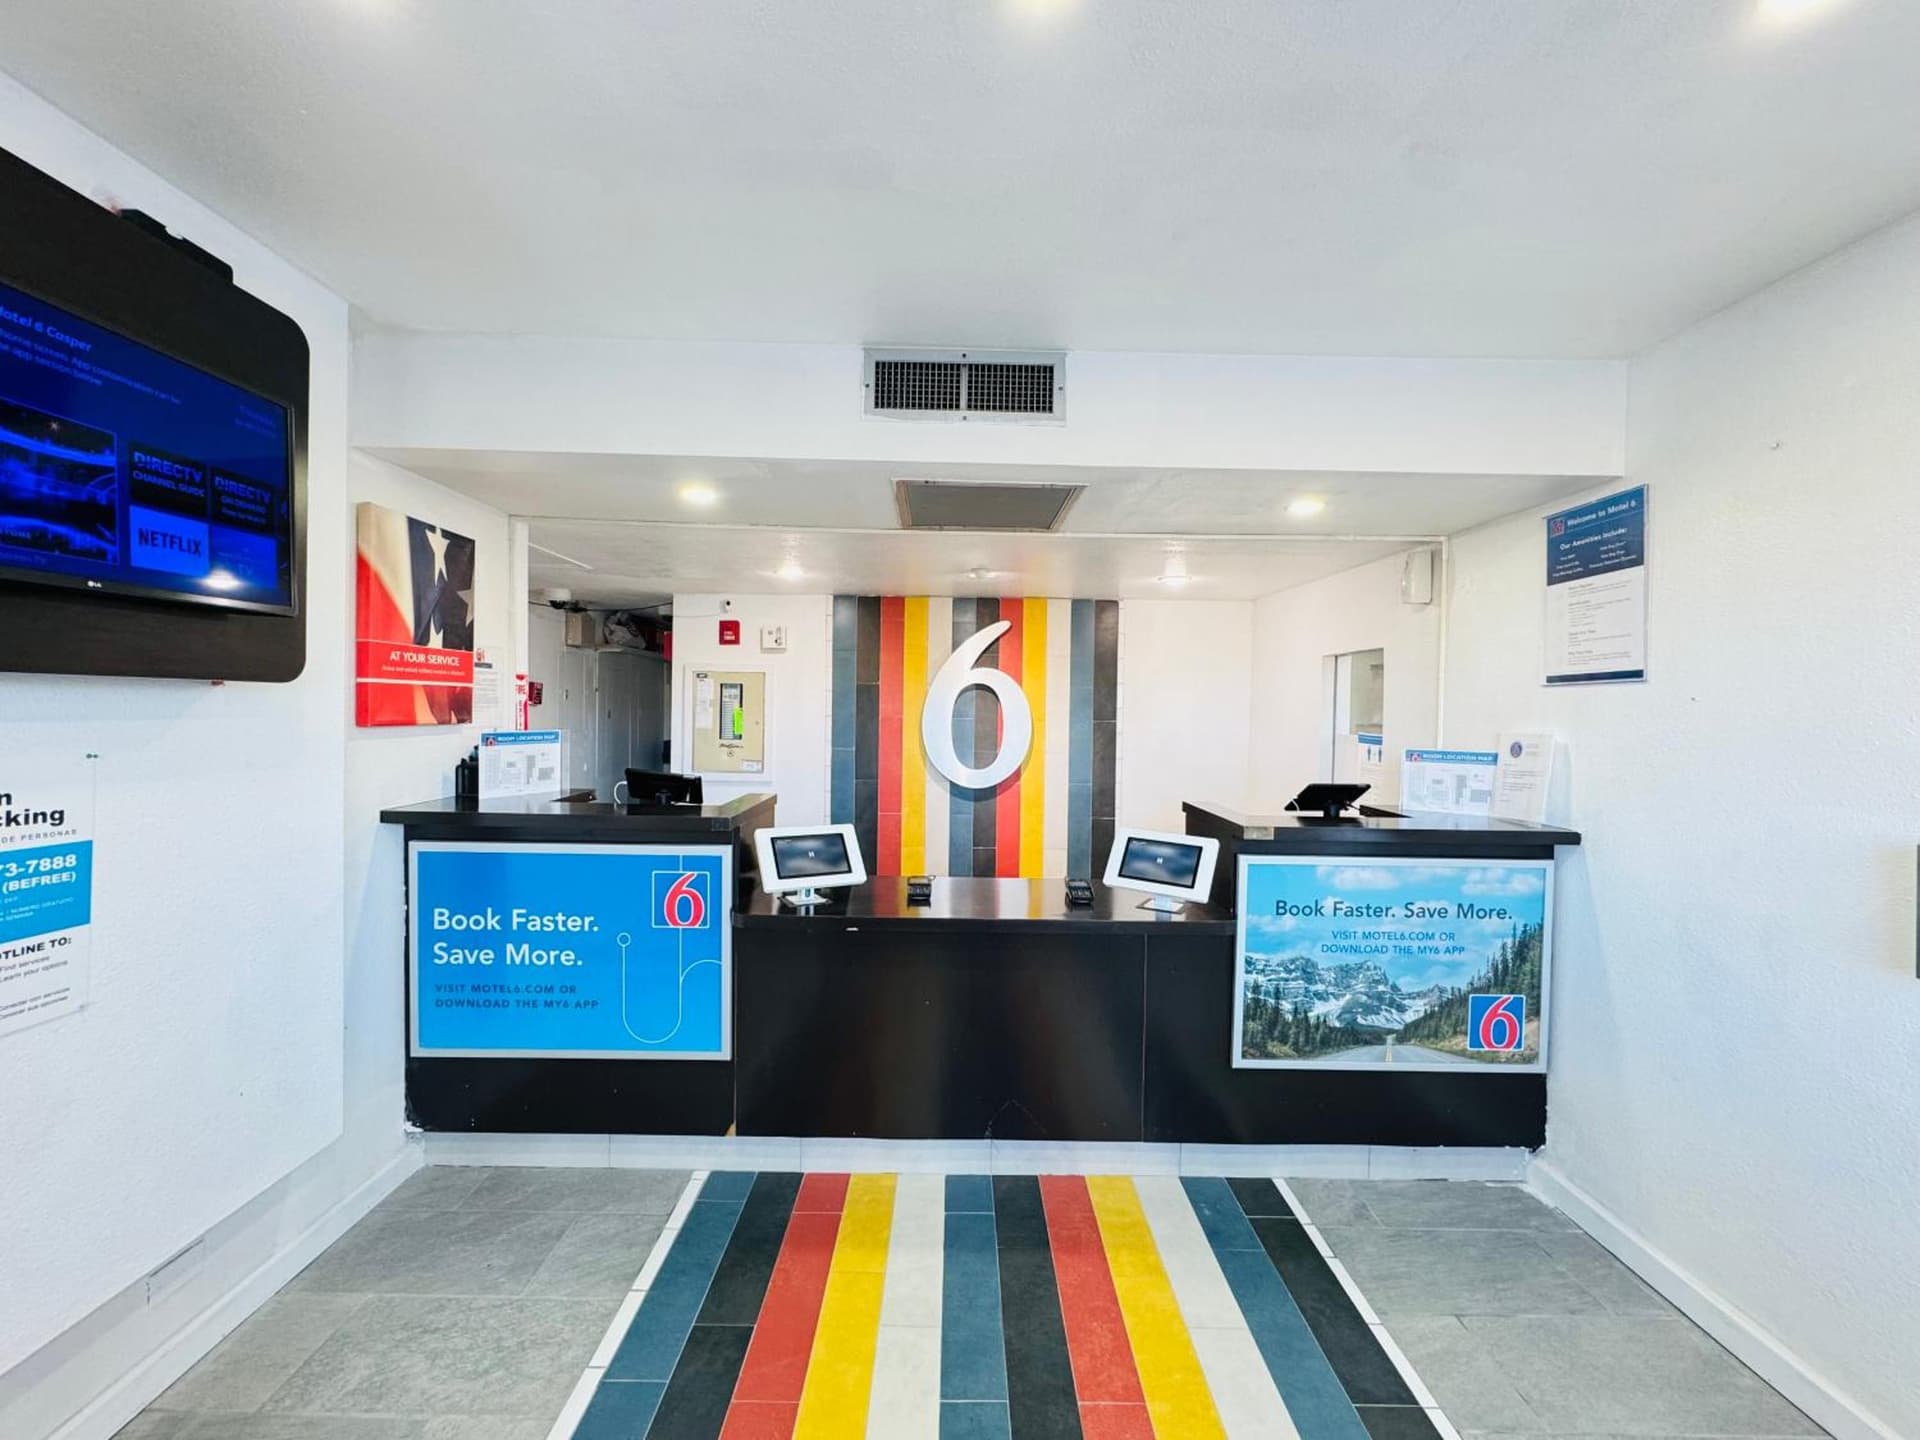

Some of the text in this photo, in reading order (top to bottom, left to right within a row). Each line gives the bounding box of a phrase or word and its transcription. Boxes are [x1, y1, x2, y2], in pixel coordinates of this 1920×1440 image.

[47, 327, 92, 352] Casper
[134, 451, 202, 483] DIRECTV
[215, 476, 271, 503] DIRECTV
[1567, 513, 1597, 525] Welcome
[1608, 501, 1629, 513] Motel
[138, 528, 202, 558] NETFLIX
[390, 651, 460, 666] AT YOUR SERVICE
[922, 620, 1033, 789] 6
[21, 829, 77, 841] PERSONAS
[2, 871, 76, 894] (BEFREE)
[664, 872, 705, 928] 6
[1275, 900, 1512, 920] Book Faster. Save More.
[433, 907, 599, 932] Book Faster.
[49, 937, 72, 948] TO:
[1332, 931, 1455, 941] VISIT MOTEL6.COM OR
[433, 942, 583, 967] Save More.
[1321, 944, 1464, 955] DOWNLOAD THE MY6 APP
[435, 984, 577, 994] VISIT MOTEL6.COM OR
[435, 999, 599, 1009] DOWNLOAD THE MY6 APP
[1479, 995, 1520, 1051] 6
